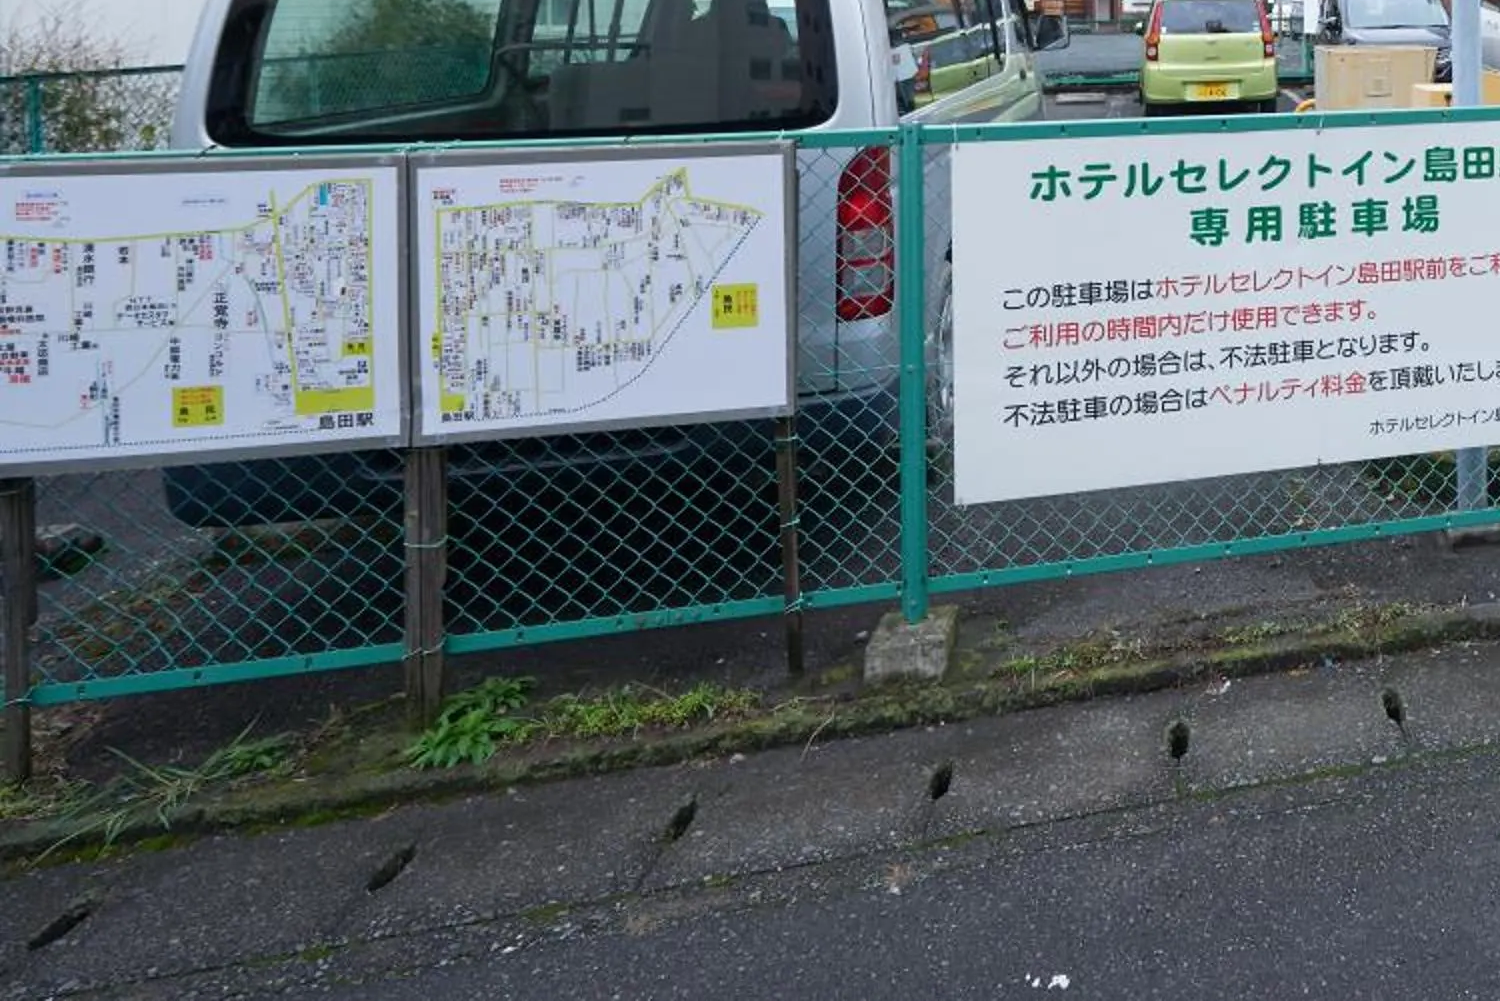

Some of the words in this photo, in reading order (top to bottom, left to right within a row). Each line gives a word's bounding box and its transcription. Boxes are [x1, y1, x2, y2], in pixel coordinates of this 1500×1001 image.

[1190, 195, 1440, 246] 専用駐車場
[1003, 299, 1377, 350] ご利用の時間内だけ使用できます。
[1004, 330, 1430, 388] それ以外の場合は、不法駐車となります。
